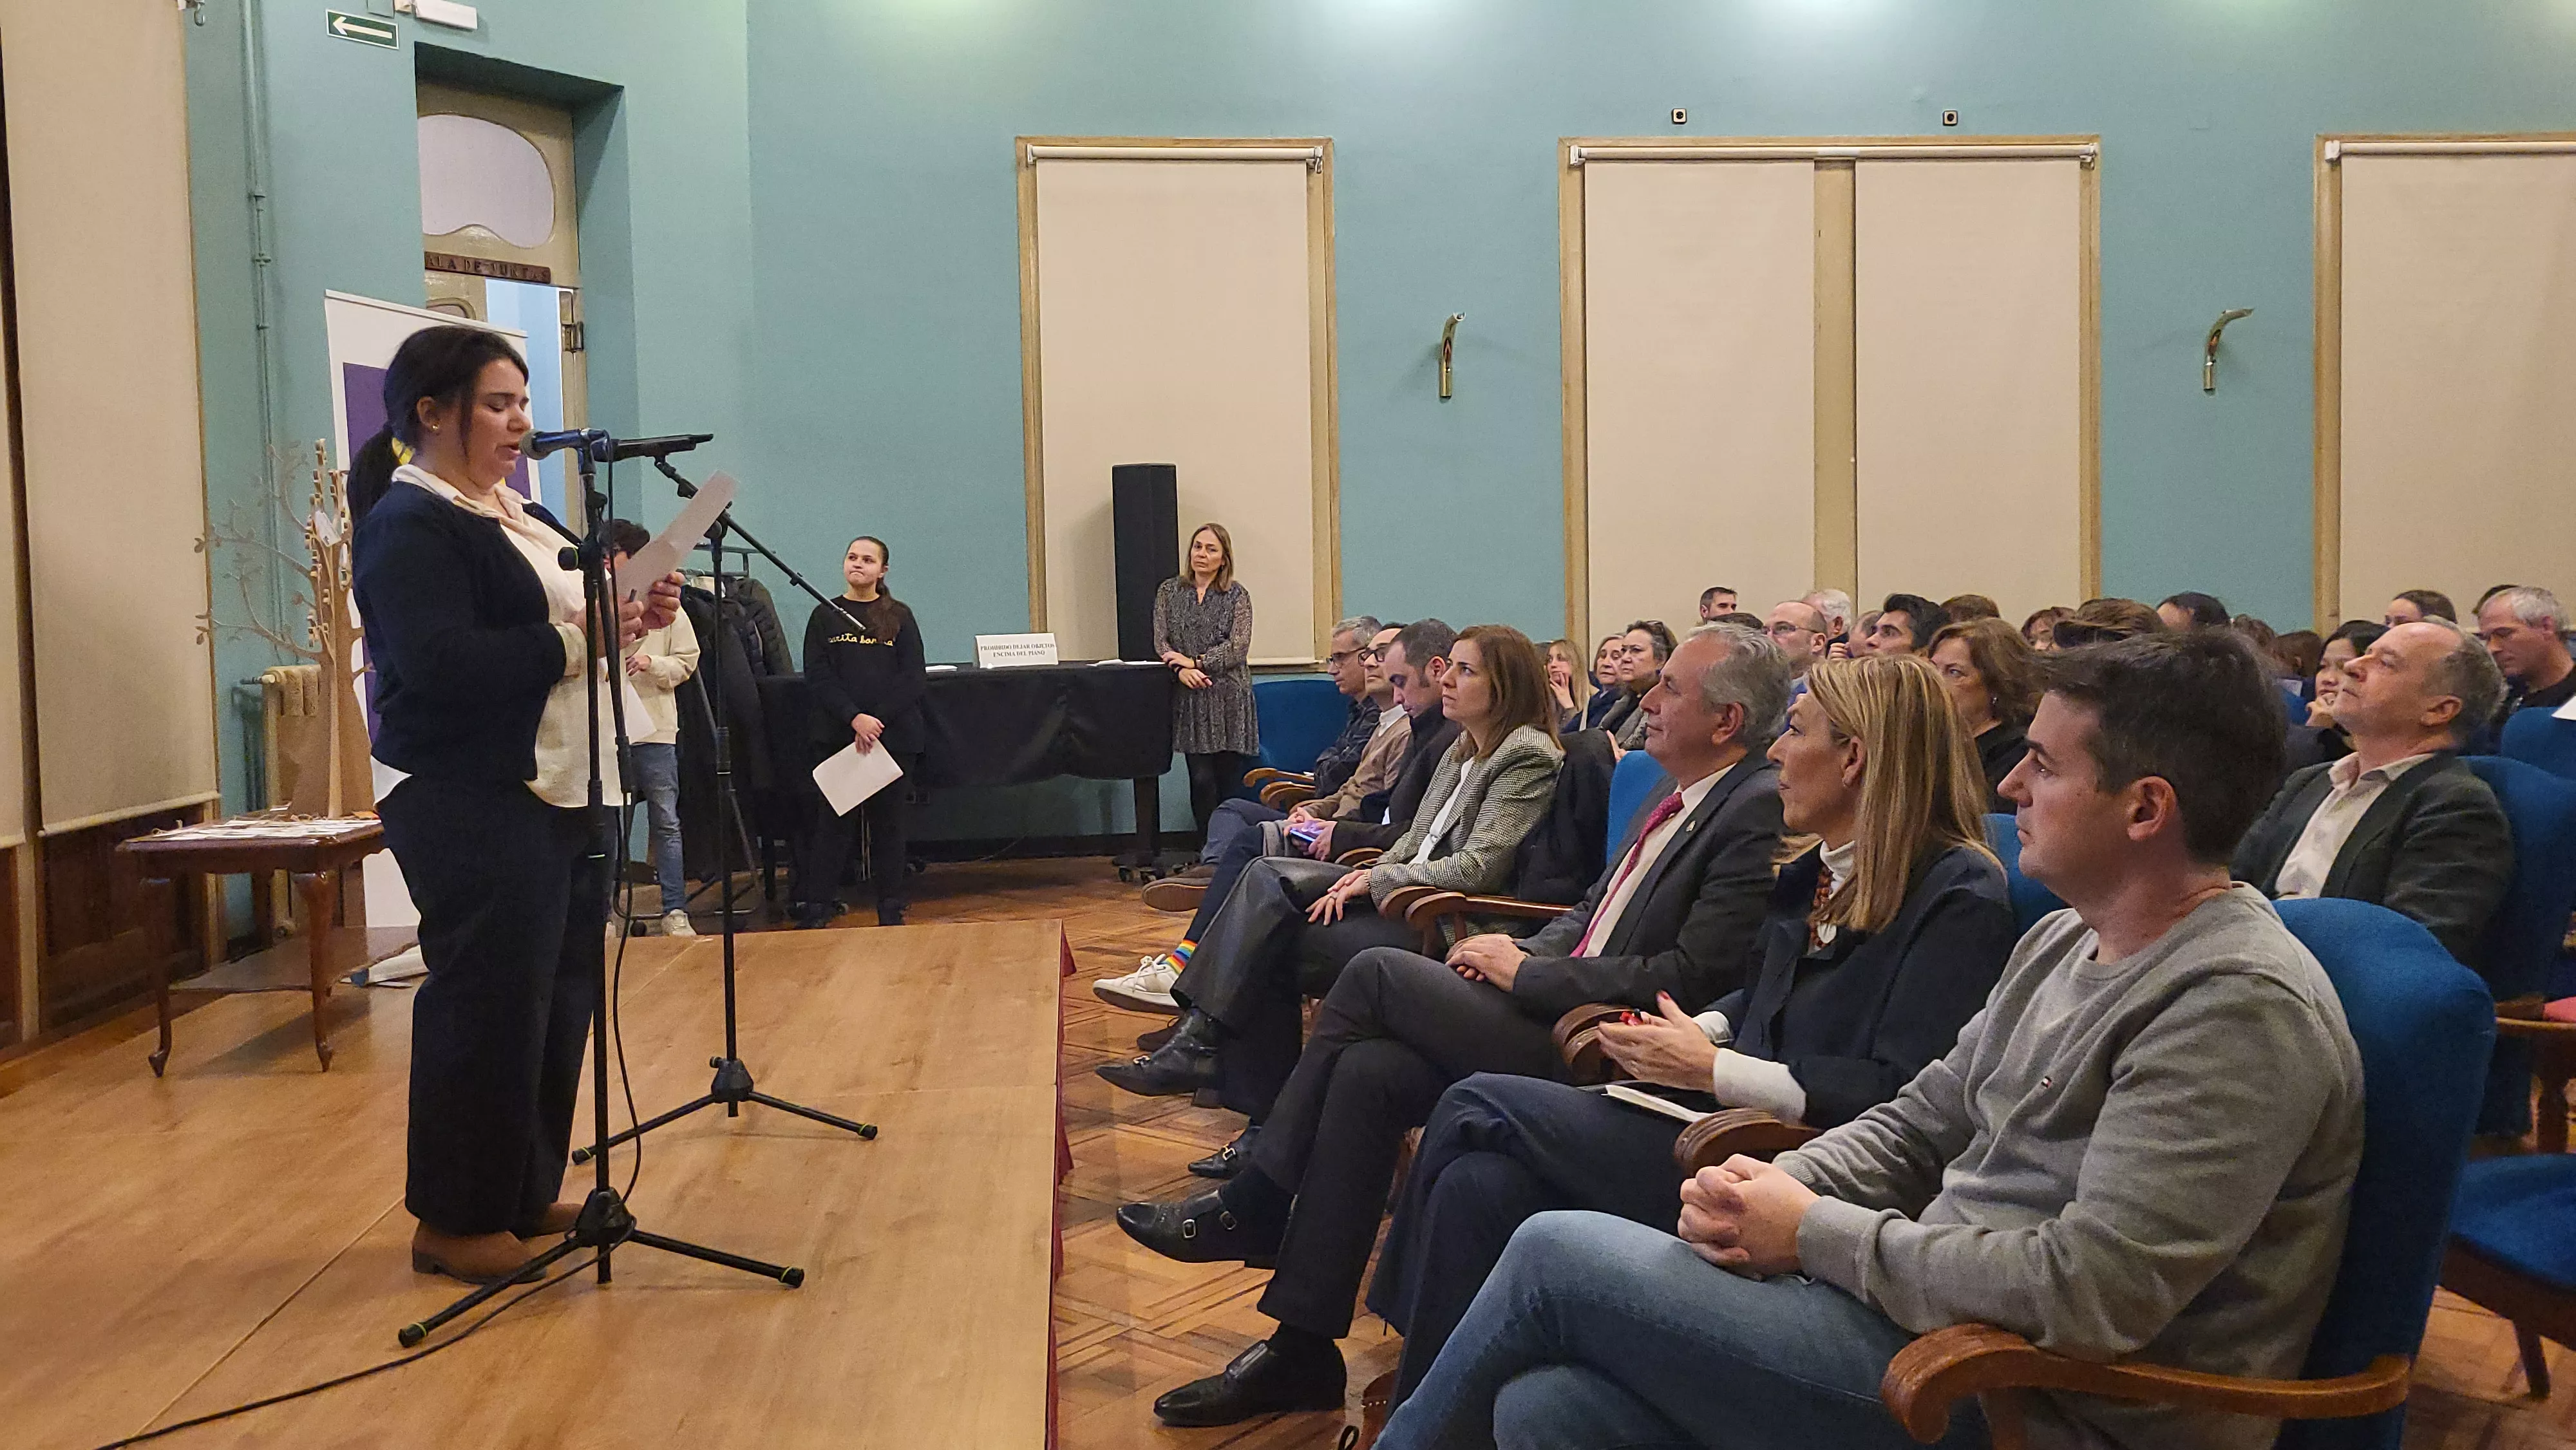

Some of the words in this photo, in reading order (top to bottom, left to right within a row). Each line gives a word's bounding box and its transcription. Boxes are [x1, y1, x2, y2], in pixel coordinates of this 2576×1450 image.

[426, 255, 457, 269] ALA
[464, 258, 482, 273] DE
[859, 635, 894, 646] bona
